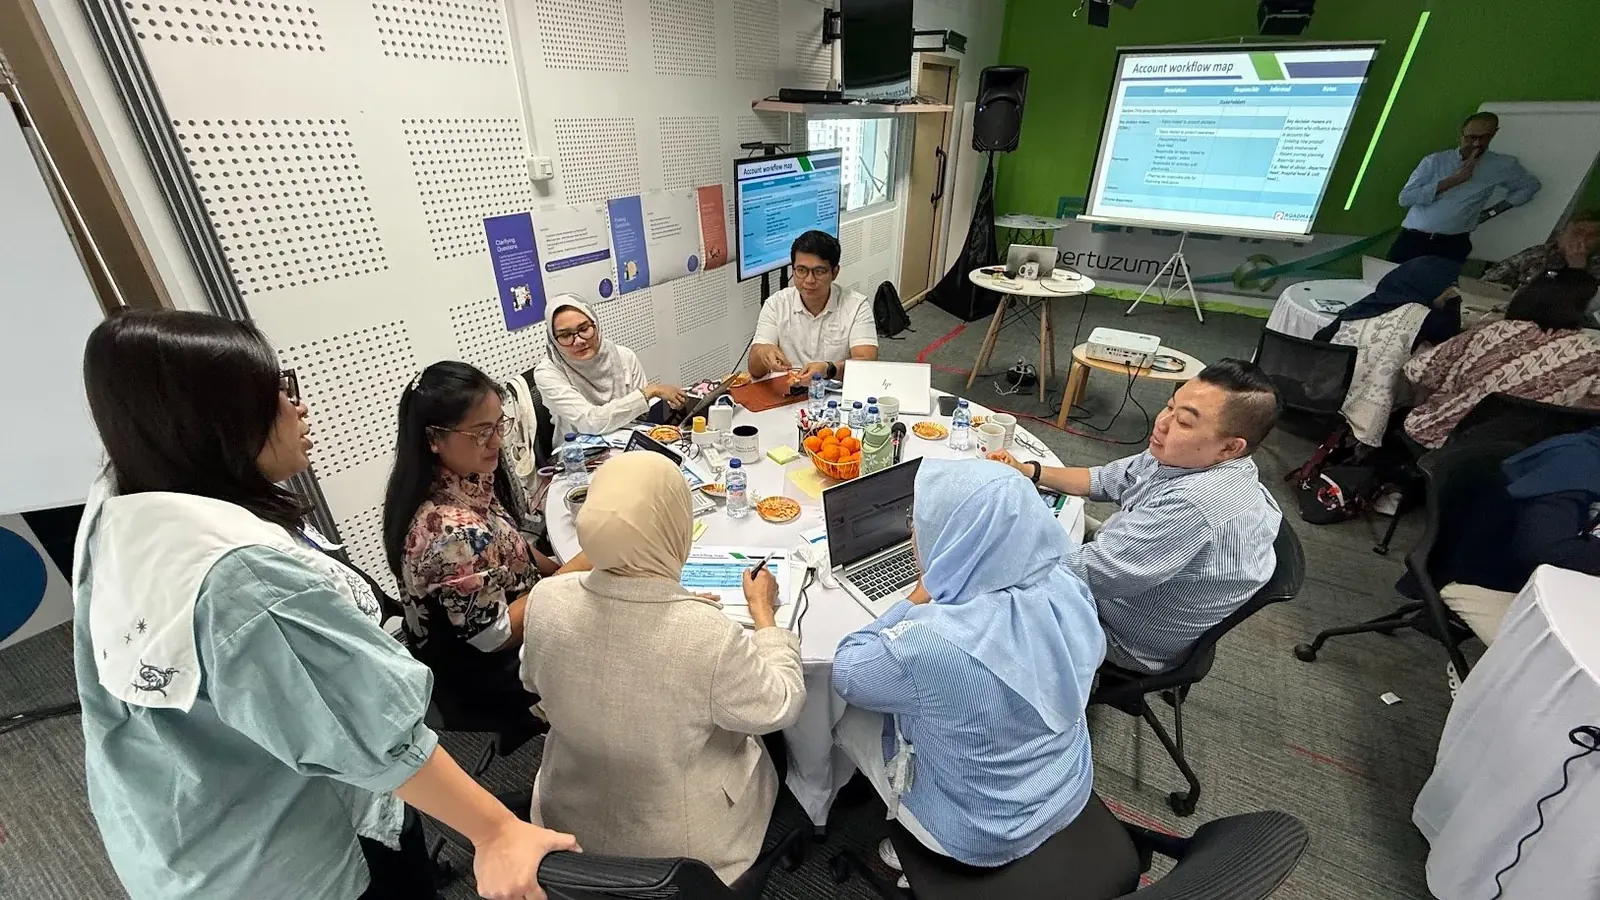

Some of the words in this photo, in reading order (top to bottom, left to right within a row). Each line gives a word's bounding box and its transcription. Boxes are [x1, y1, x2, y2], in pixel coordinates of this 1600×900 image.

[1132, 63, 1167, 74] Account
[1169, 61, 1211, 73] workflow
[1213, 62, 1234, 74] map
[744, 167, 762, 176] Account
[763, 163, 783, 173] workflow
[783, 162, 793, 171] map
[495, 237, 516, 246] Clarifying
[497, 244, 519, 252] Questions
